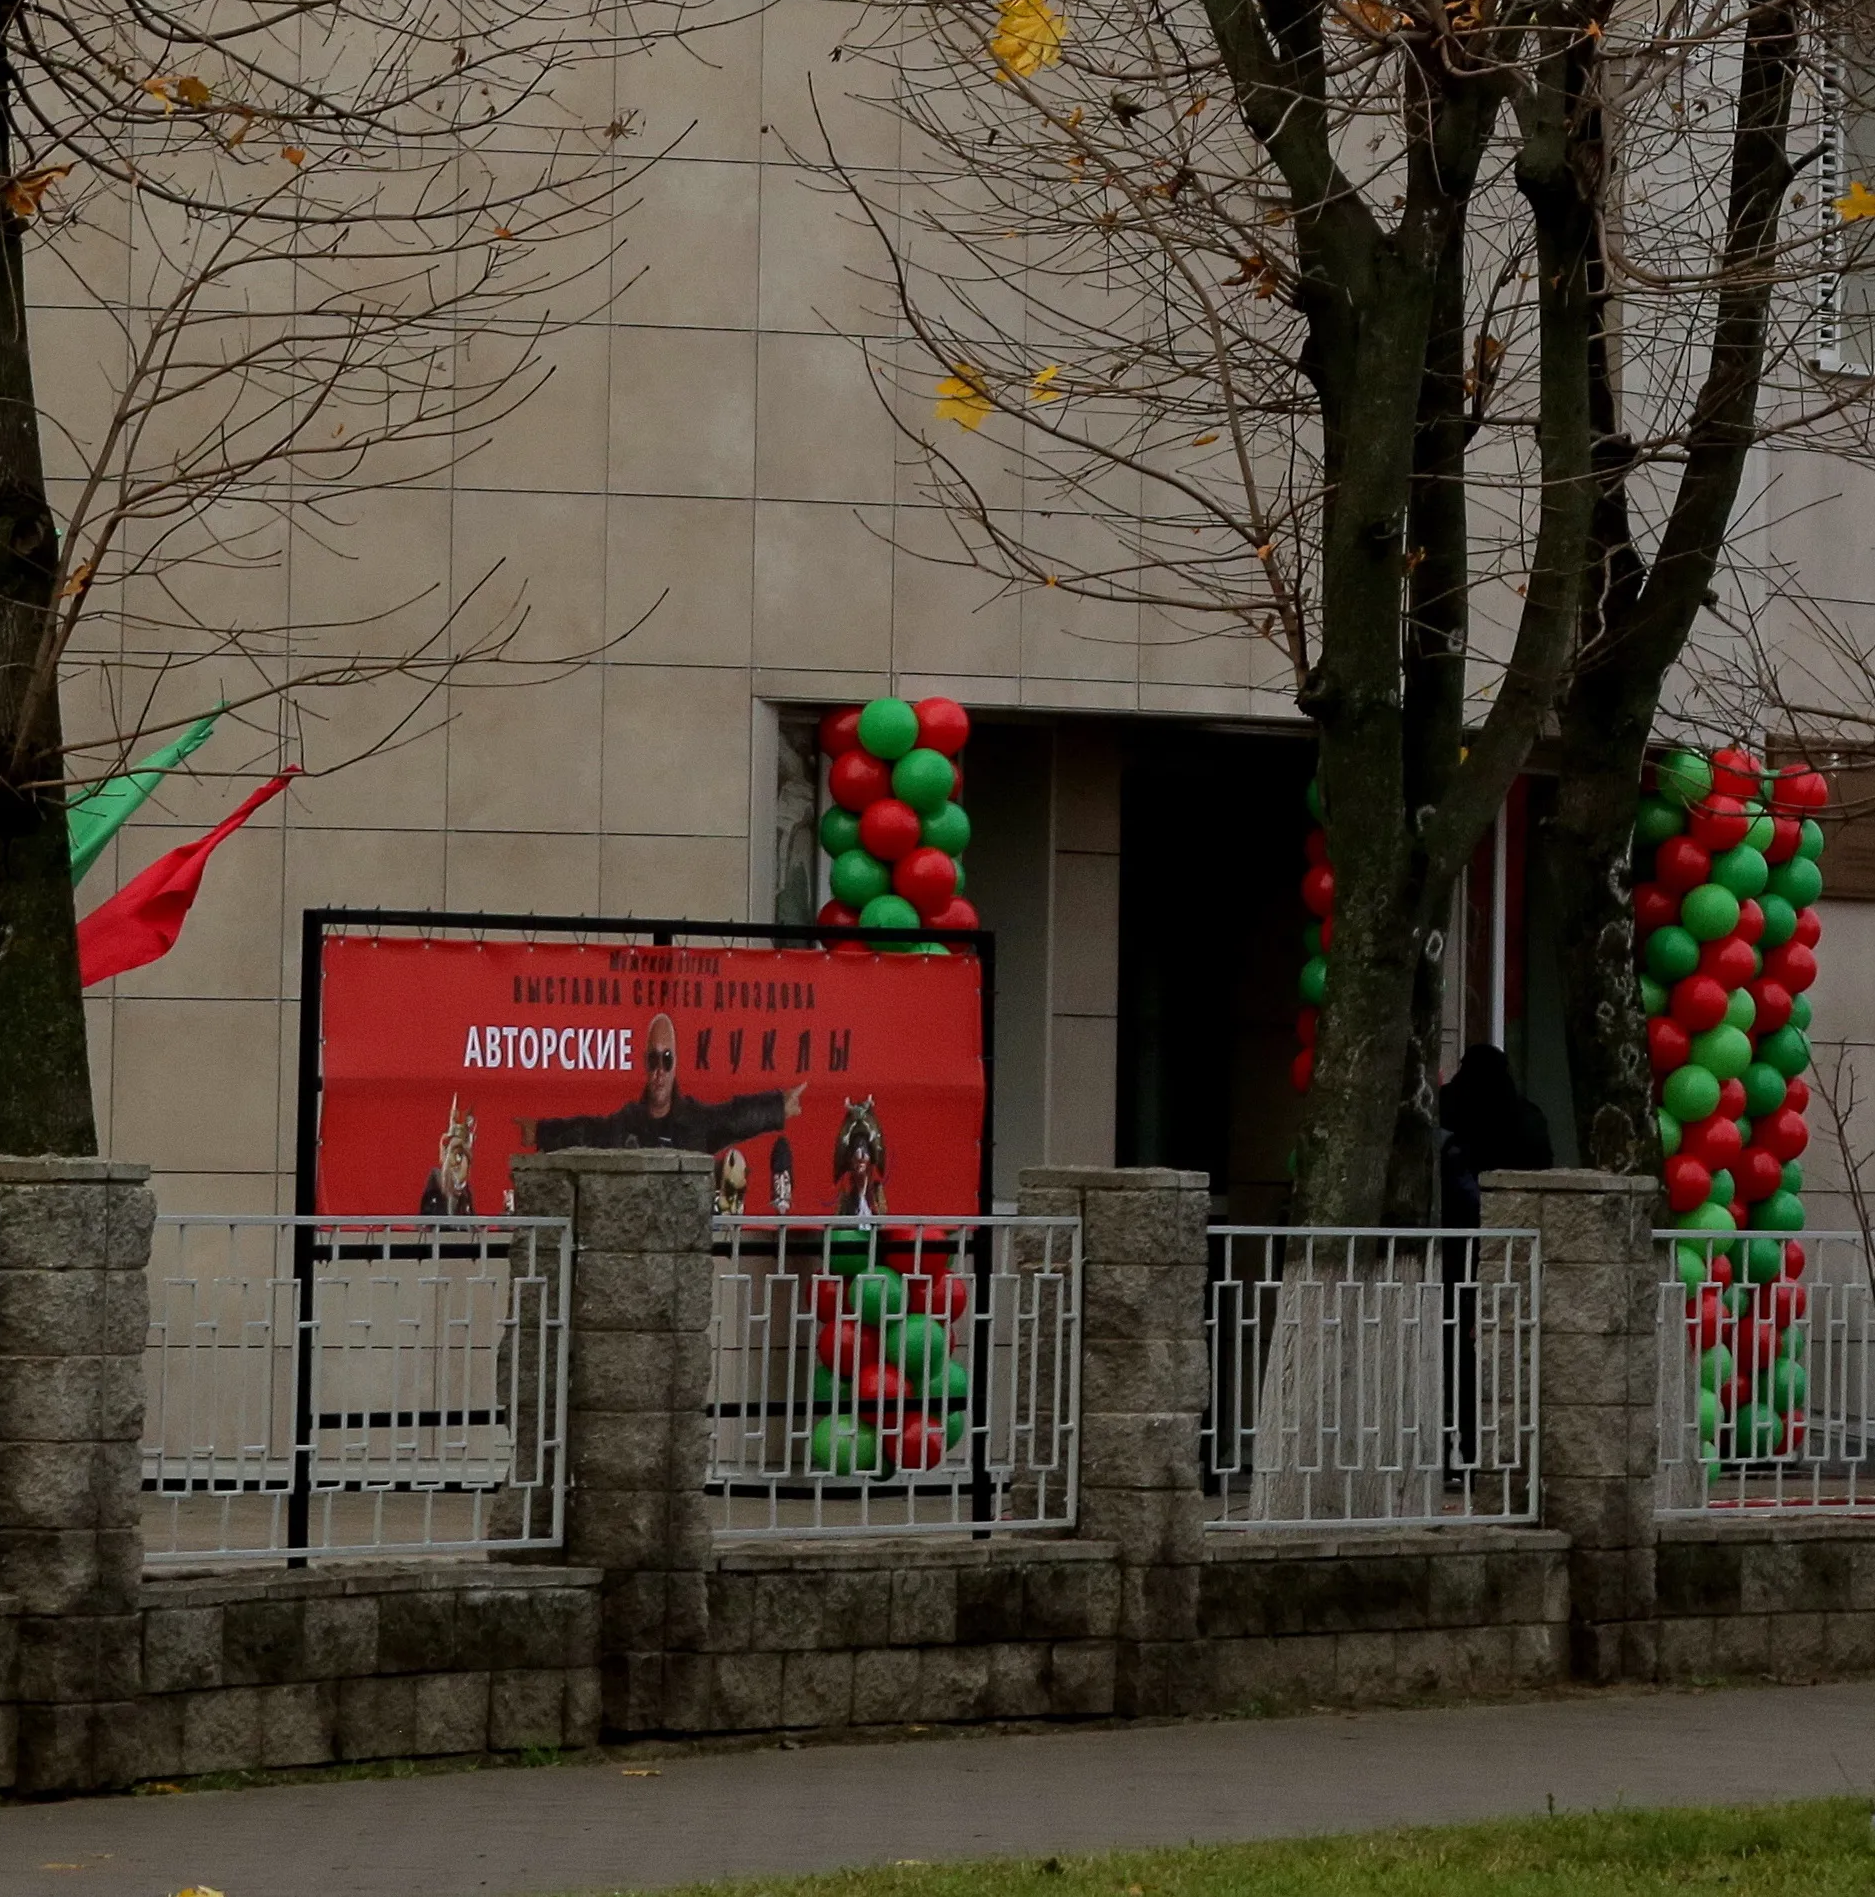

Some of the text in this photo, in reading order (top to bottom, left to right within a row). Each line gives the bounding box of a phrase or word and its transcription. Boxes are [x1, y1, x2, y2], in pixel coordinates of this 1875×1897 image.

[513, 975, 622, 1005] ВЫСТАВКА
[714, 981, 816, 1011] ДРОЗДОВА
[463, 1025, 633, 1070] АВТОРСКИЕ
